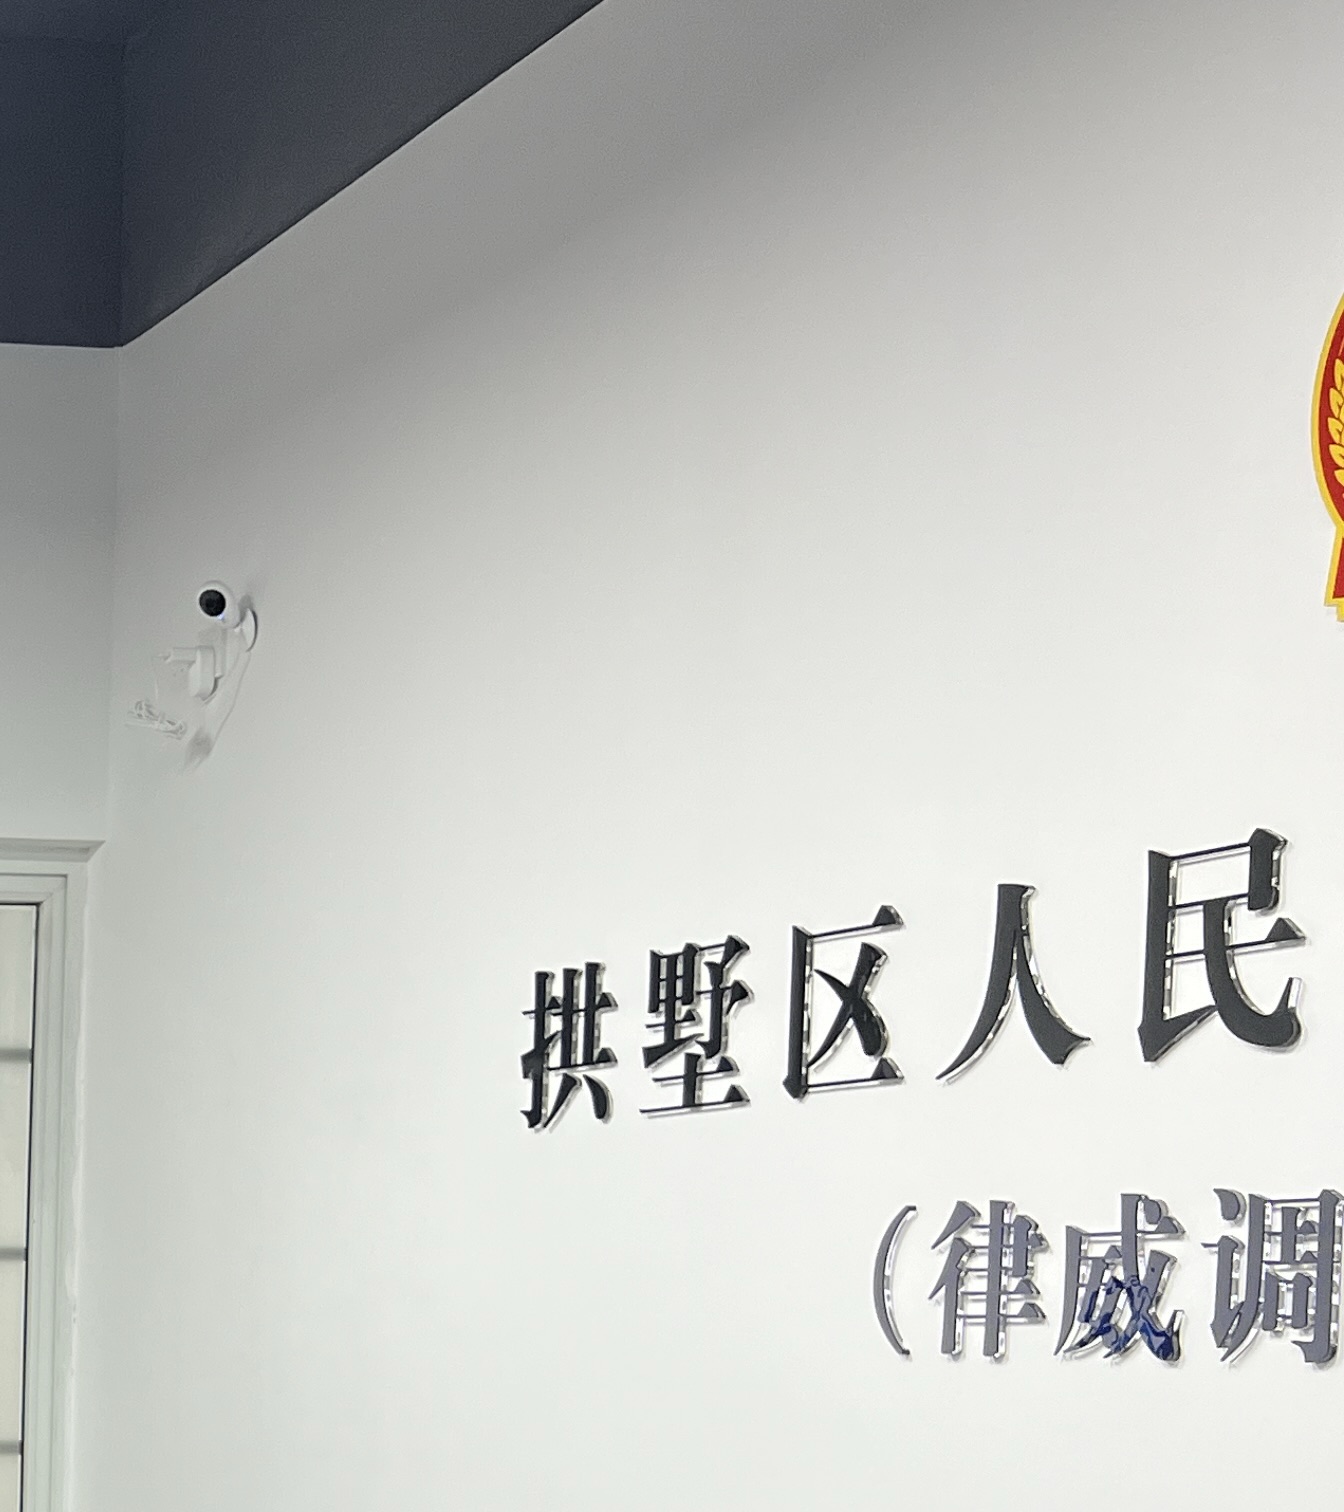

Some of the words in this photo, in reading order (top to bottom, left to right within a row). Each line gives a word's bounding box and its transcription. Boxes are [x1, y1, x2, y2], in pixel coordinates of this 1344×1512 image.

[519, 828, 1307, 1131] 拱墅区人民
